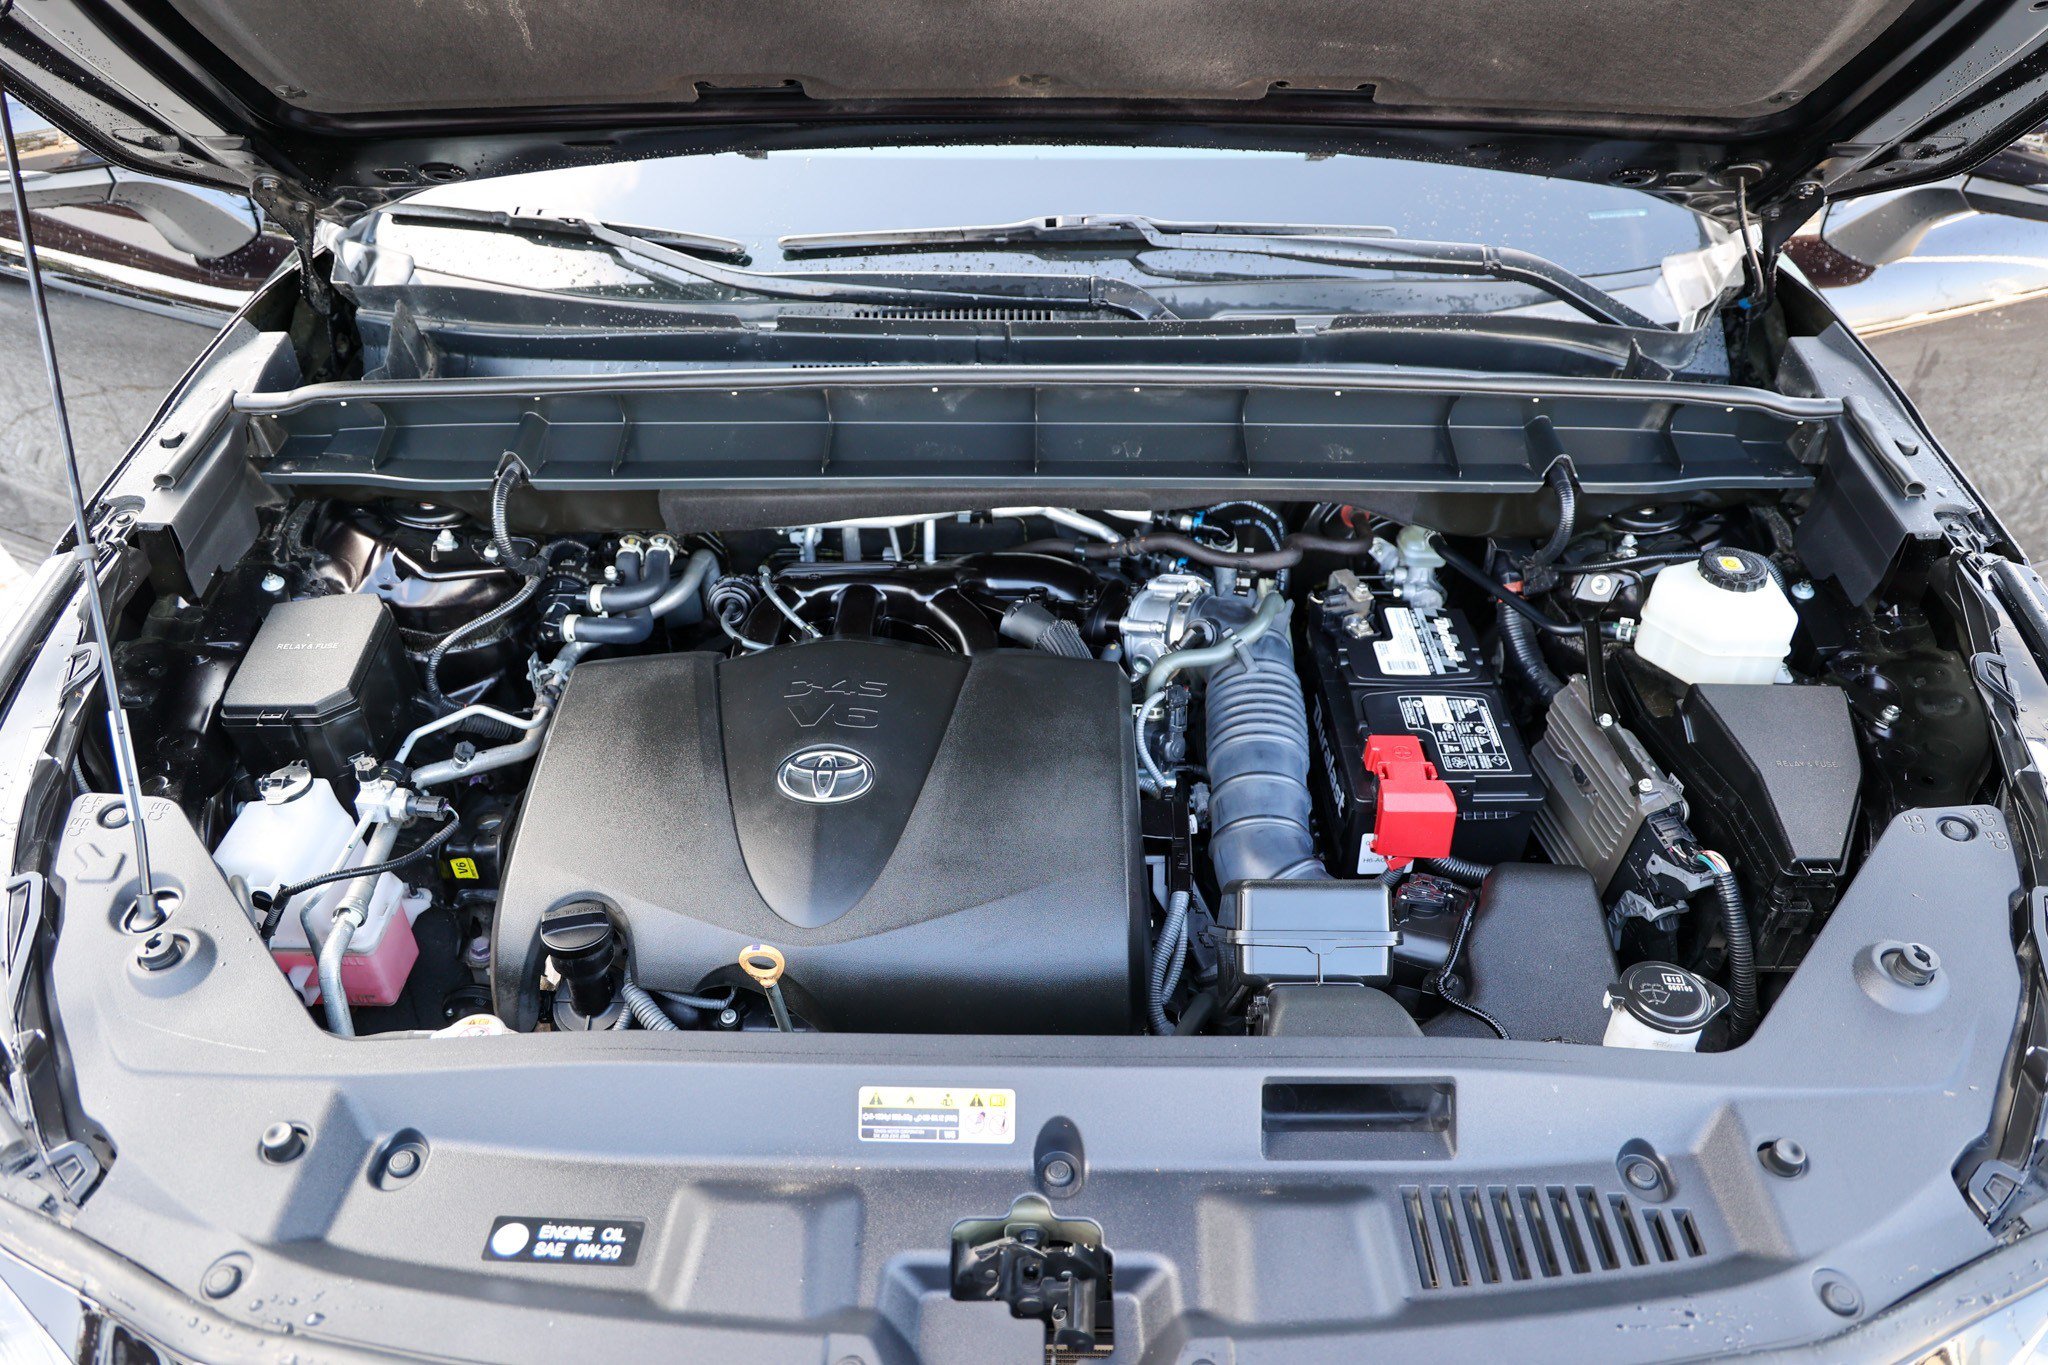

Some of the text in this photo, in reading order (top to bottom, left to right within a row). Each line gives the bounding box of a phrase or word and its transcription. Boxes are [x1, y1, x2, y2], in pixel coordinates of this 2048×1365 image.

[787, 703, 879, 729] V6
[1313, 693, 1345, 818] Duralast
[456, 862, 468, 874] V6
[538, 1225, 626, 1242] ENGINE OIL
[533, 1241, 622, 1260] SAE 0W-20
